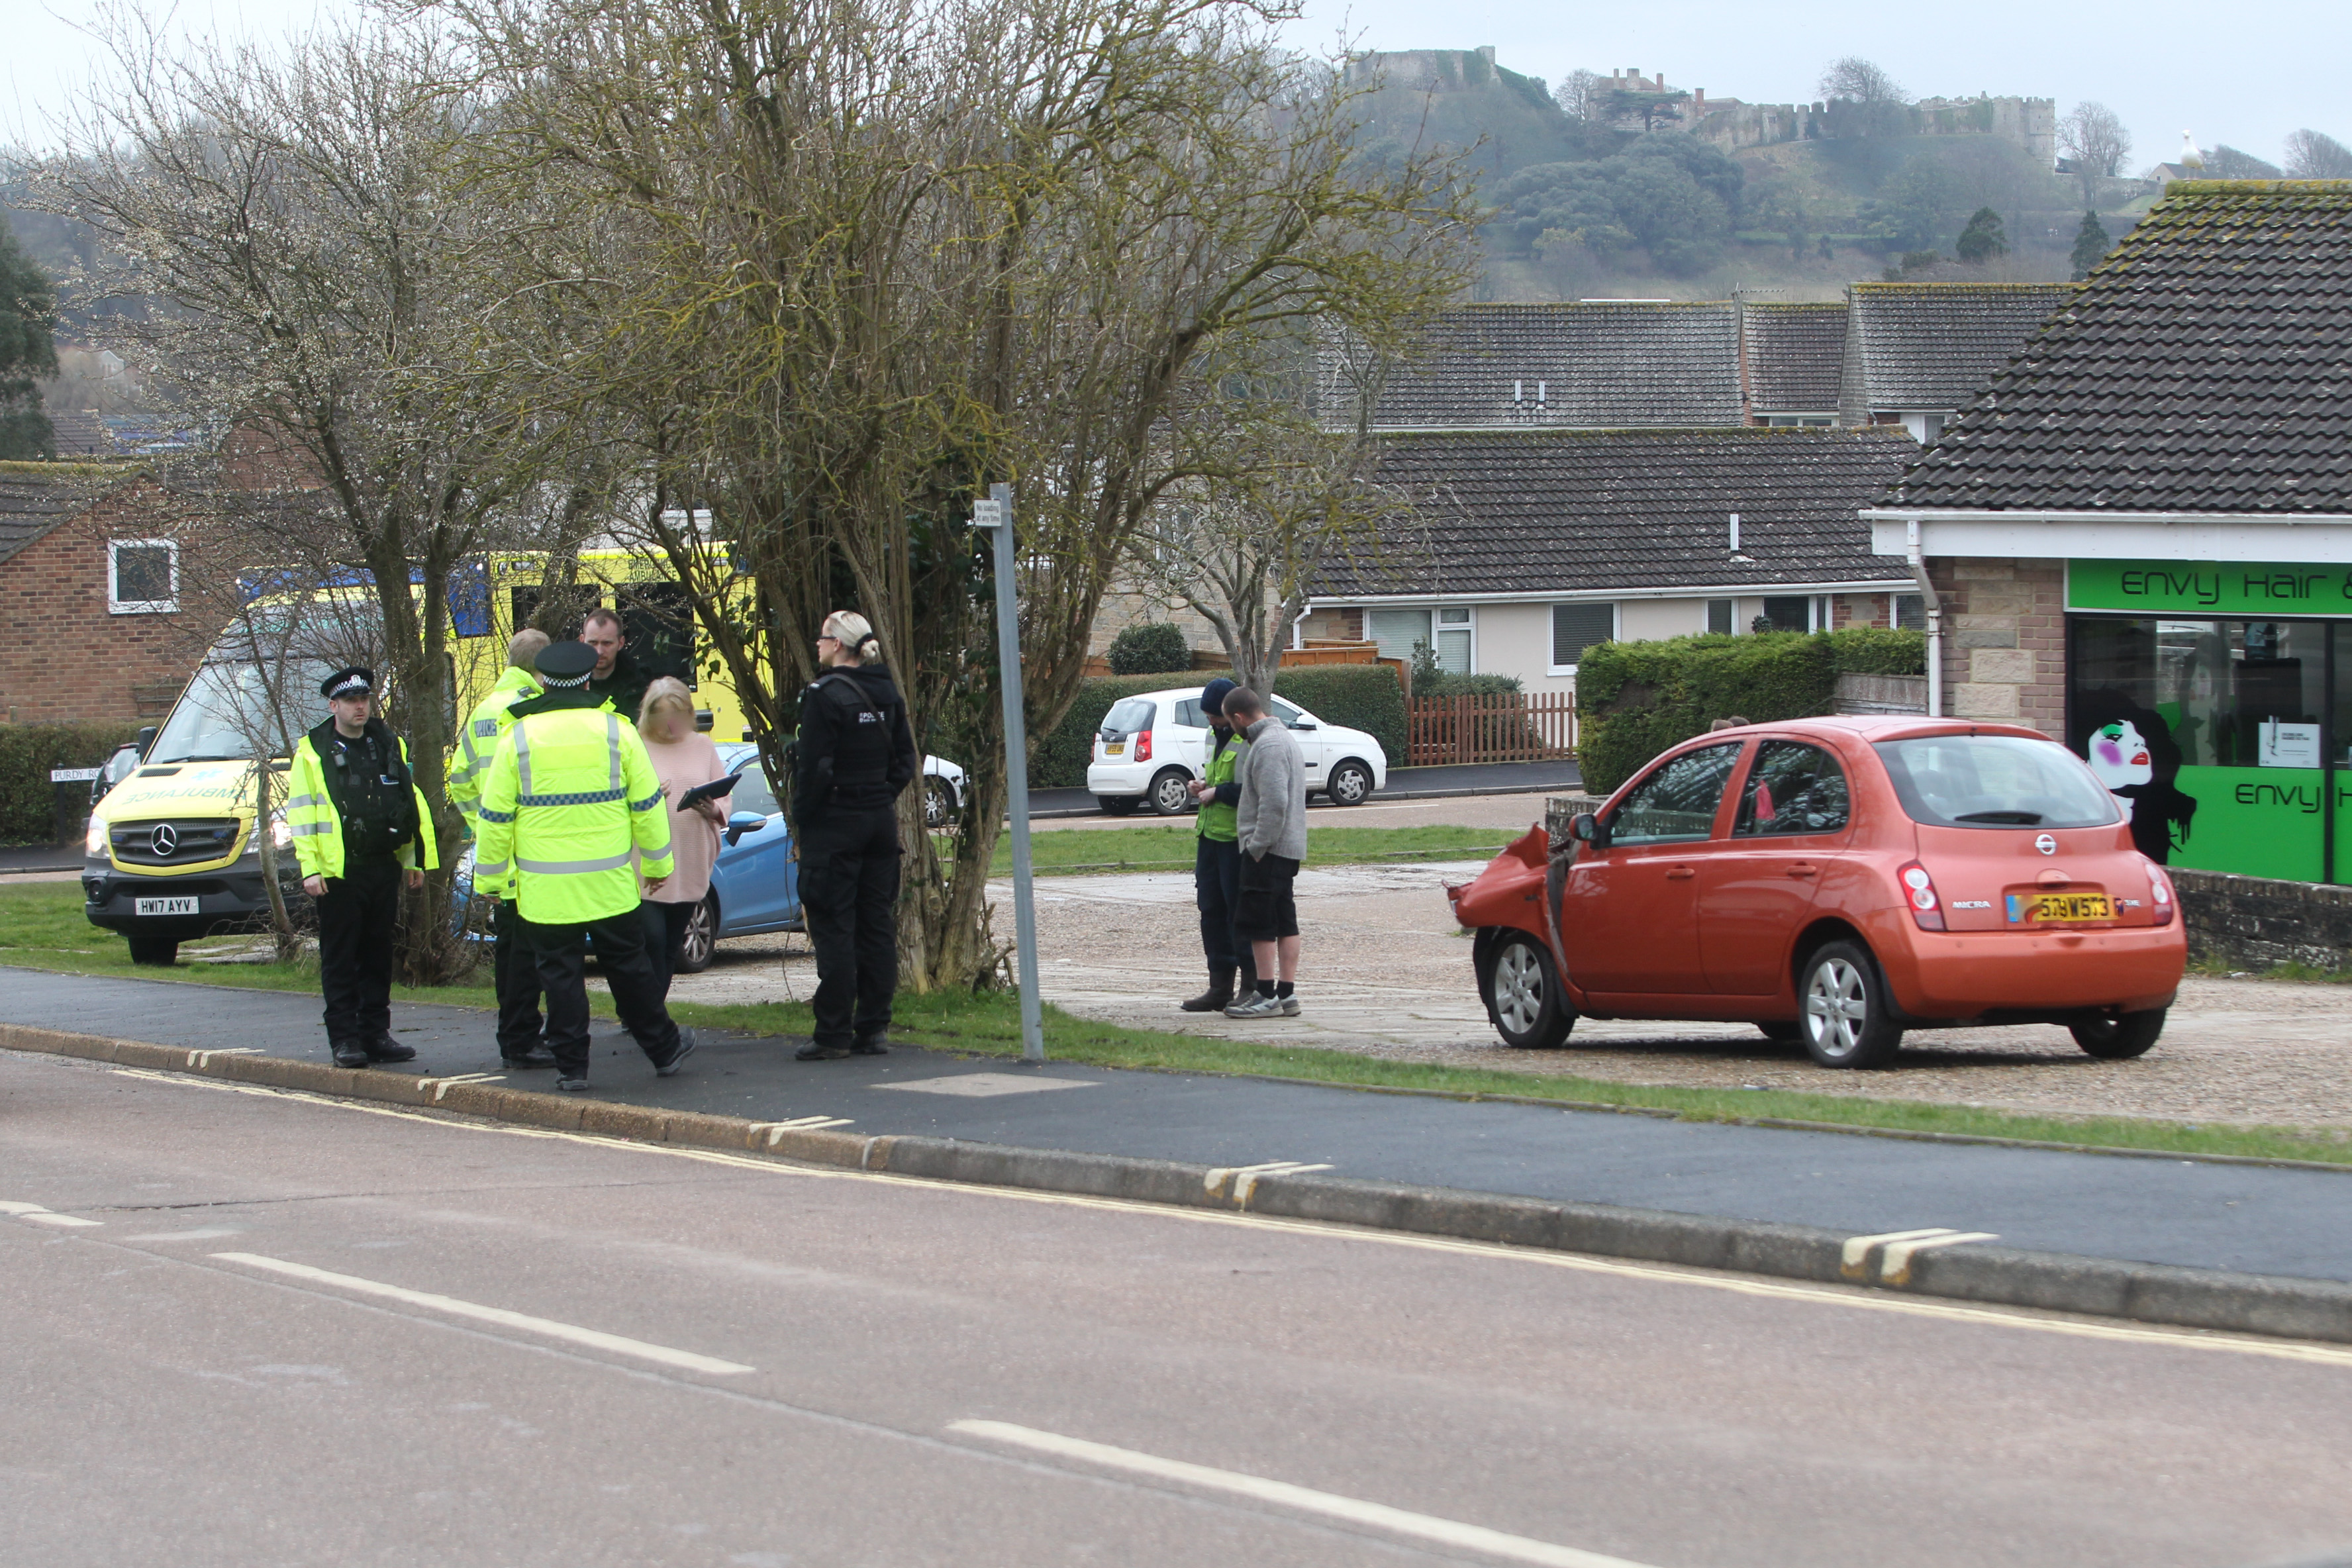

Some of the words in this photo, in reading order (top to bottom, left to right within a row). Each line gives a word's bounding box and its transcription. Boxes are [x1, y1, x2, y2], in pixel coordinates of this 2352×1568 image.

[984, 503, 999, 513] loading
[55, 770, 85, 780] PURDY
[141, 901, 165, 913] HW17
[168, 899, 191, 912] AYV
[1953, 900, 1991, 909] MICRA
